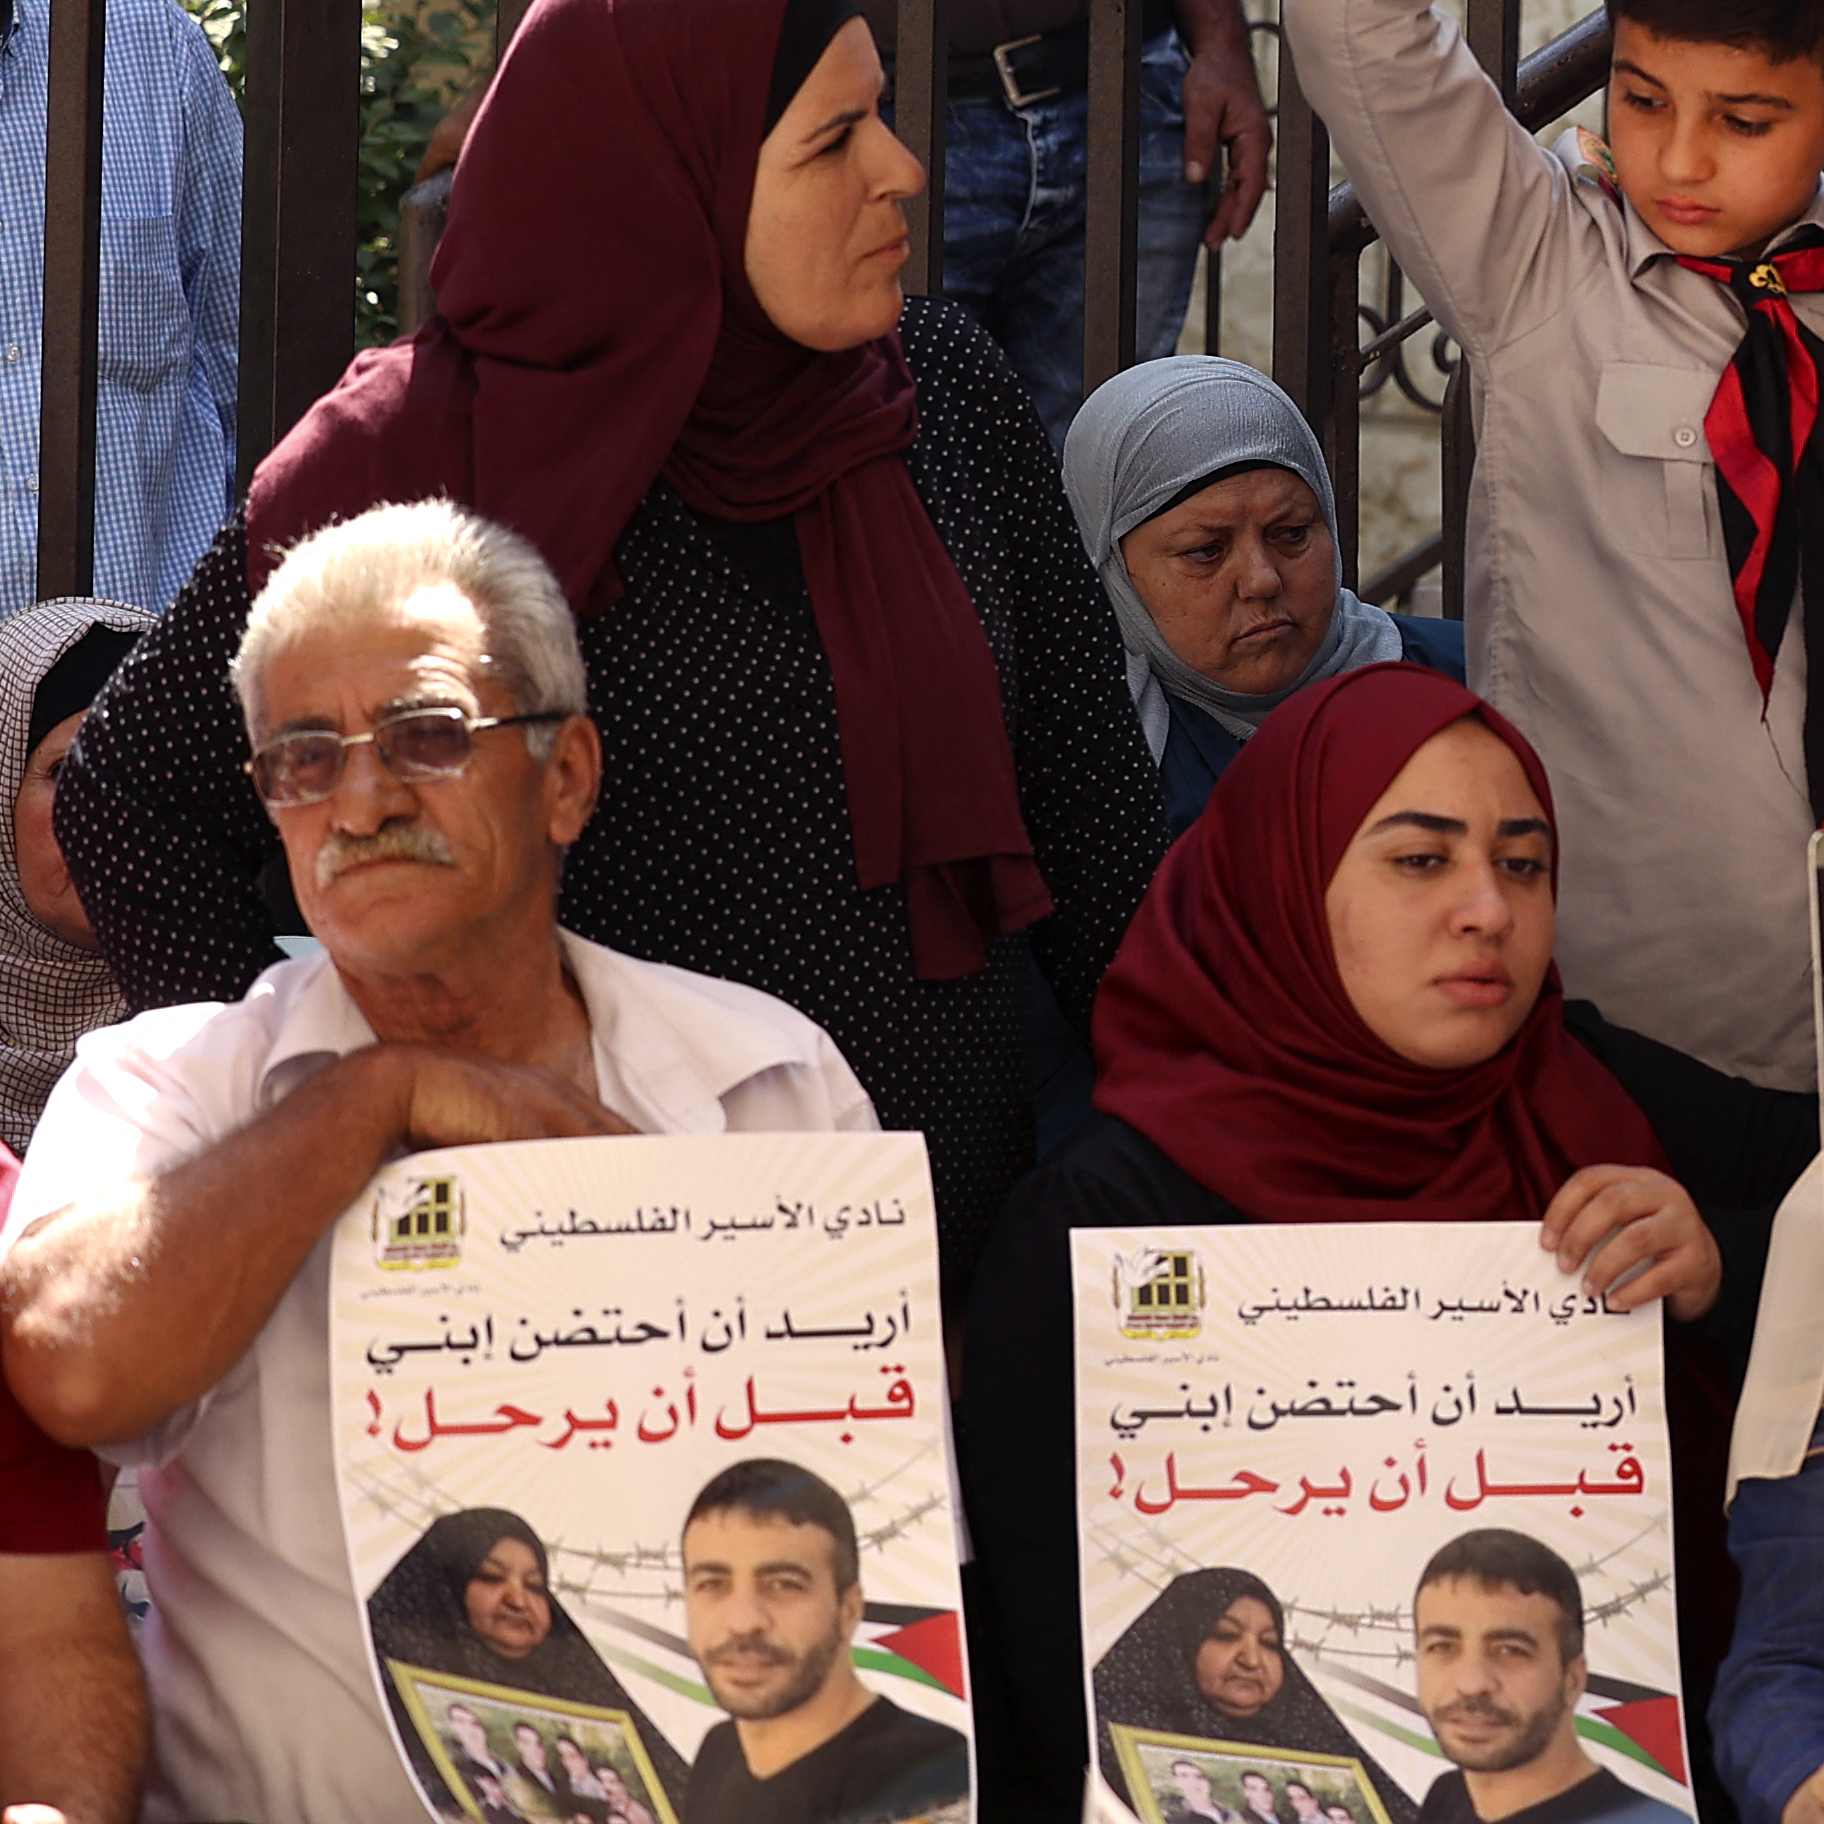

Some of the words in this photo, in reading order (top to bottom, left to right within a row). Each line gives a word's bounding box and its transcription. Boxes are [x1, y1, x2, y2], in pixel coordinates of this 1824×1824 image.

[499, 1207, 691, 1251] الفلسطيني
[699, 1194, 814, 1241] الأسير
[824, 1199, 905, 1240] نادي
[510, 1299, 687, 1363] أحتضن
[702, 1297, 747, 1352] أن
[766, 1289, 912, 1351] أريد
[1238, 1287, 1421, 1327] الفلسطيني
[1430, 1280, 1540, 1328] الأسير
[366, 1314, 494, 1374] إبني
[636, 1367, 696, 1443] أن
[715, 1364, 916, 1444] قبل
[1109, 1383, 1233, 1439] إبني
[1247, 1370, 1417, 1430] أحتضن
[1431, 1373, 1476, 1427] أن
[1496, 1375, 1637, 1428] أريد
[1369, 1438, 1427, 1513] أن
[1445, 1442, 1644, 1517] قبل
